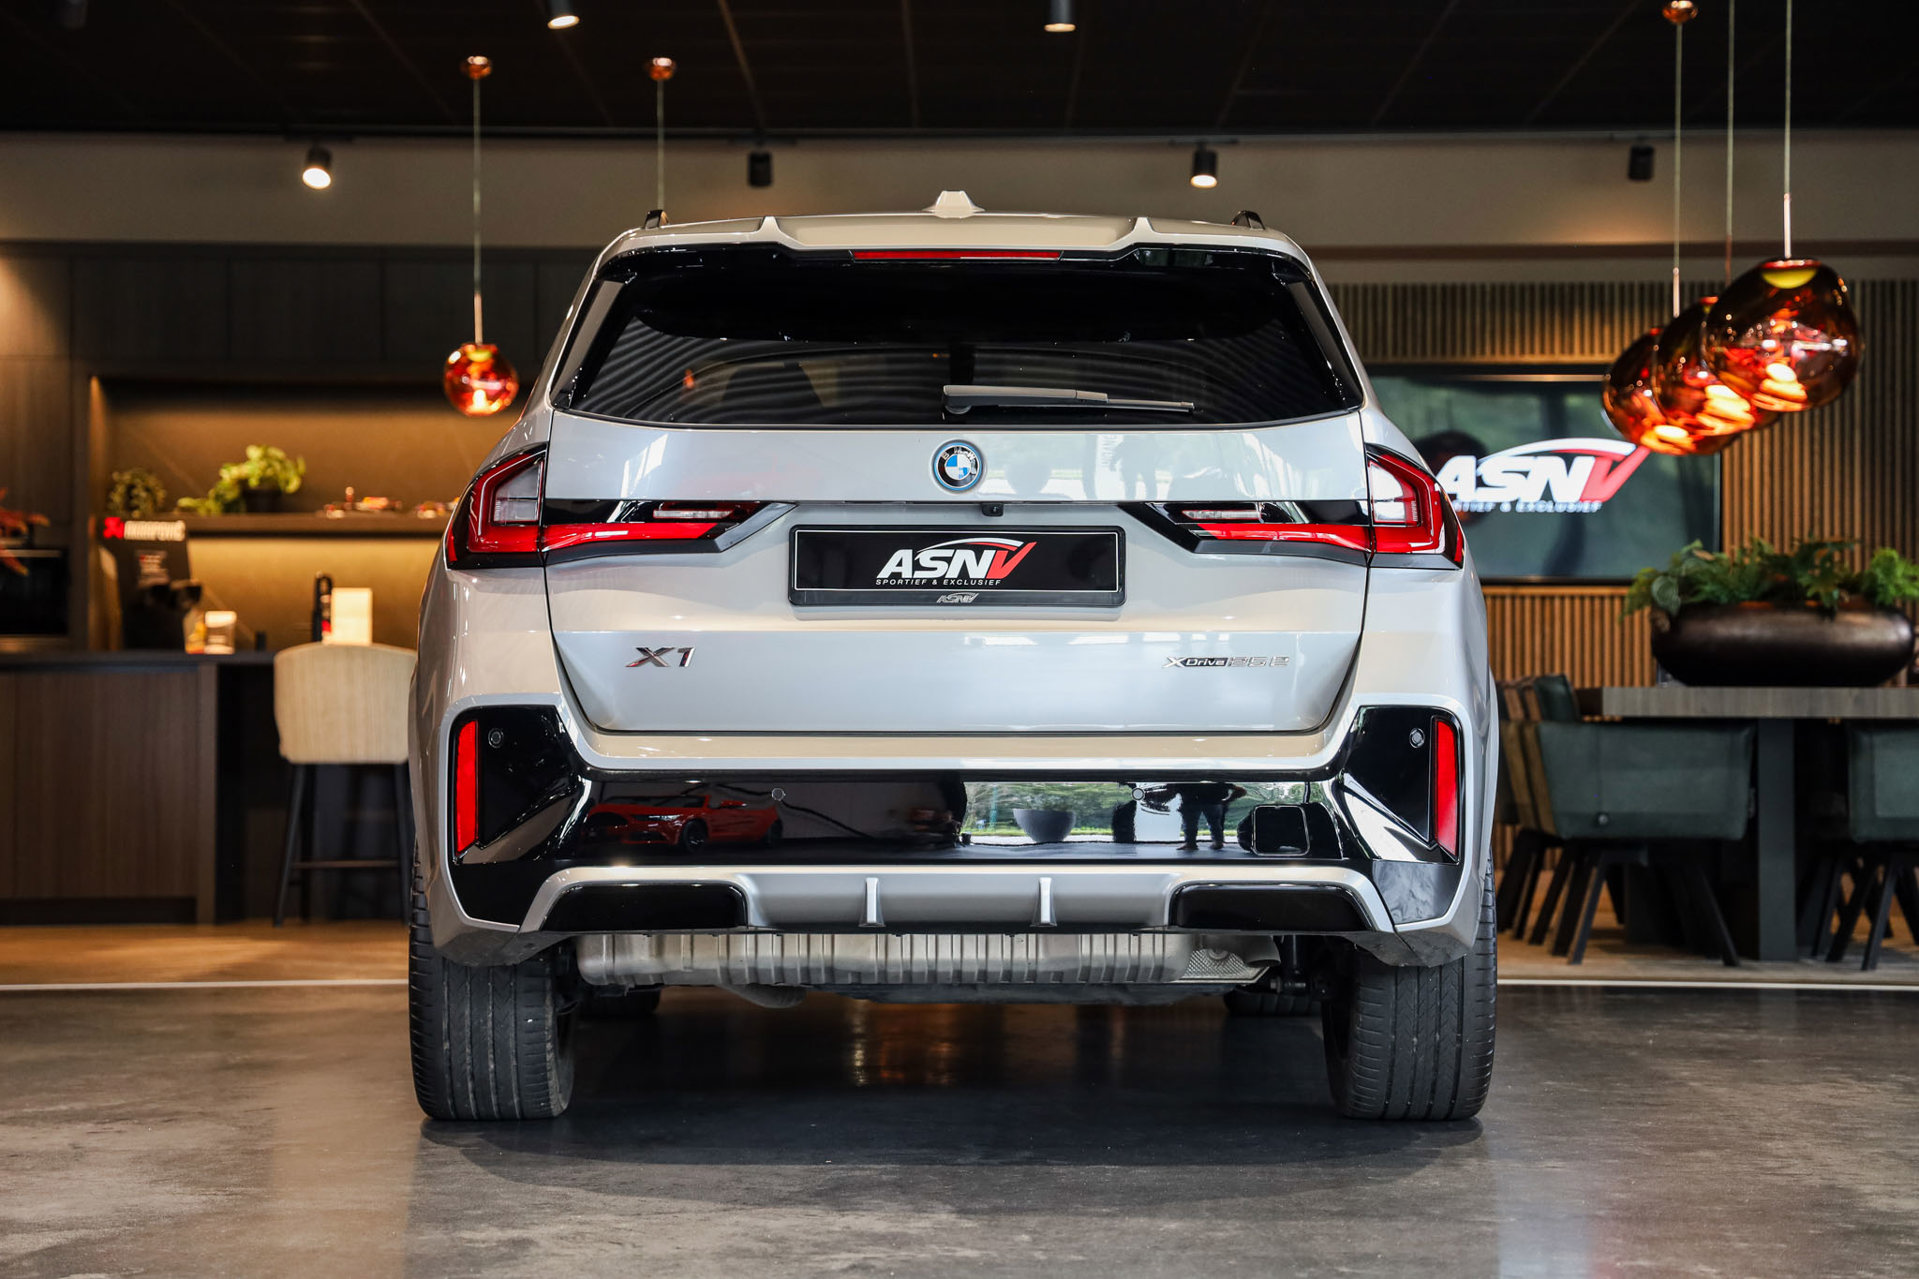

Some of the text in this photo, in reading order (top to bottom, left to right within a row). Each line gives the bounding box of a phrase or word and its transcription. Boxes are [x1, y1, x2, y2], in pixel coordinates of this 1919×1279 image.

[1434, 438, 1650, 502] ASNV
[876, 537, 1037, 579] ASNV
[625, 647, 695, 668] X1
